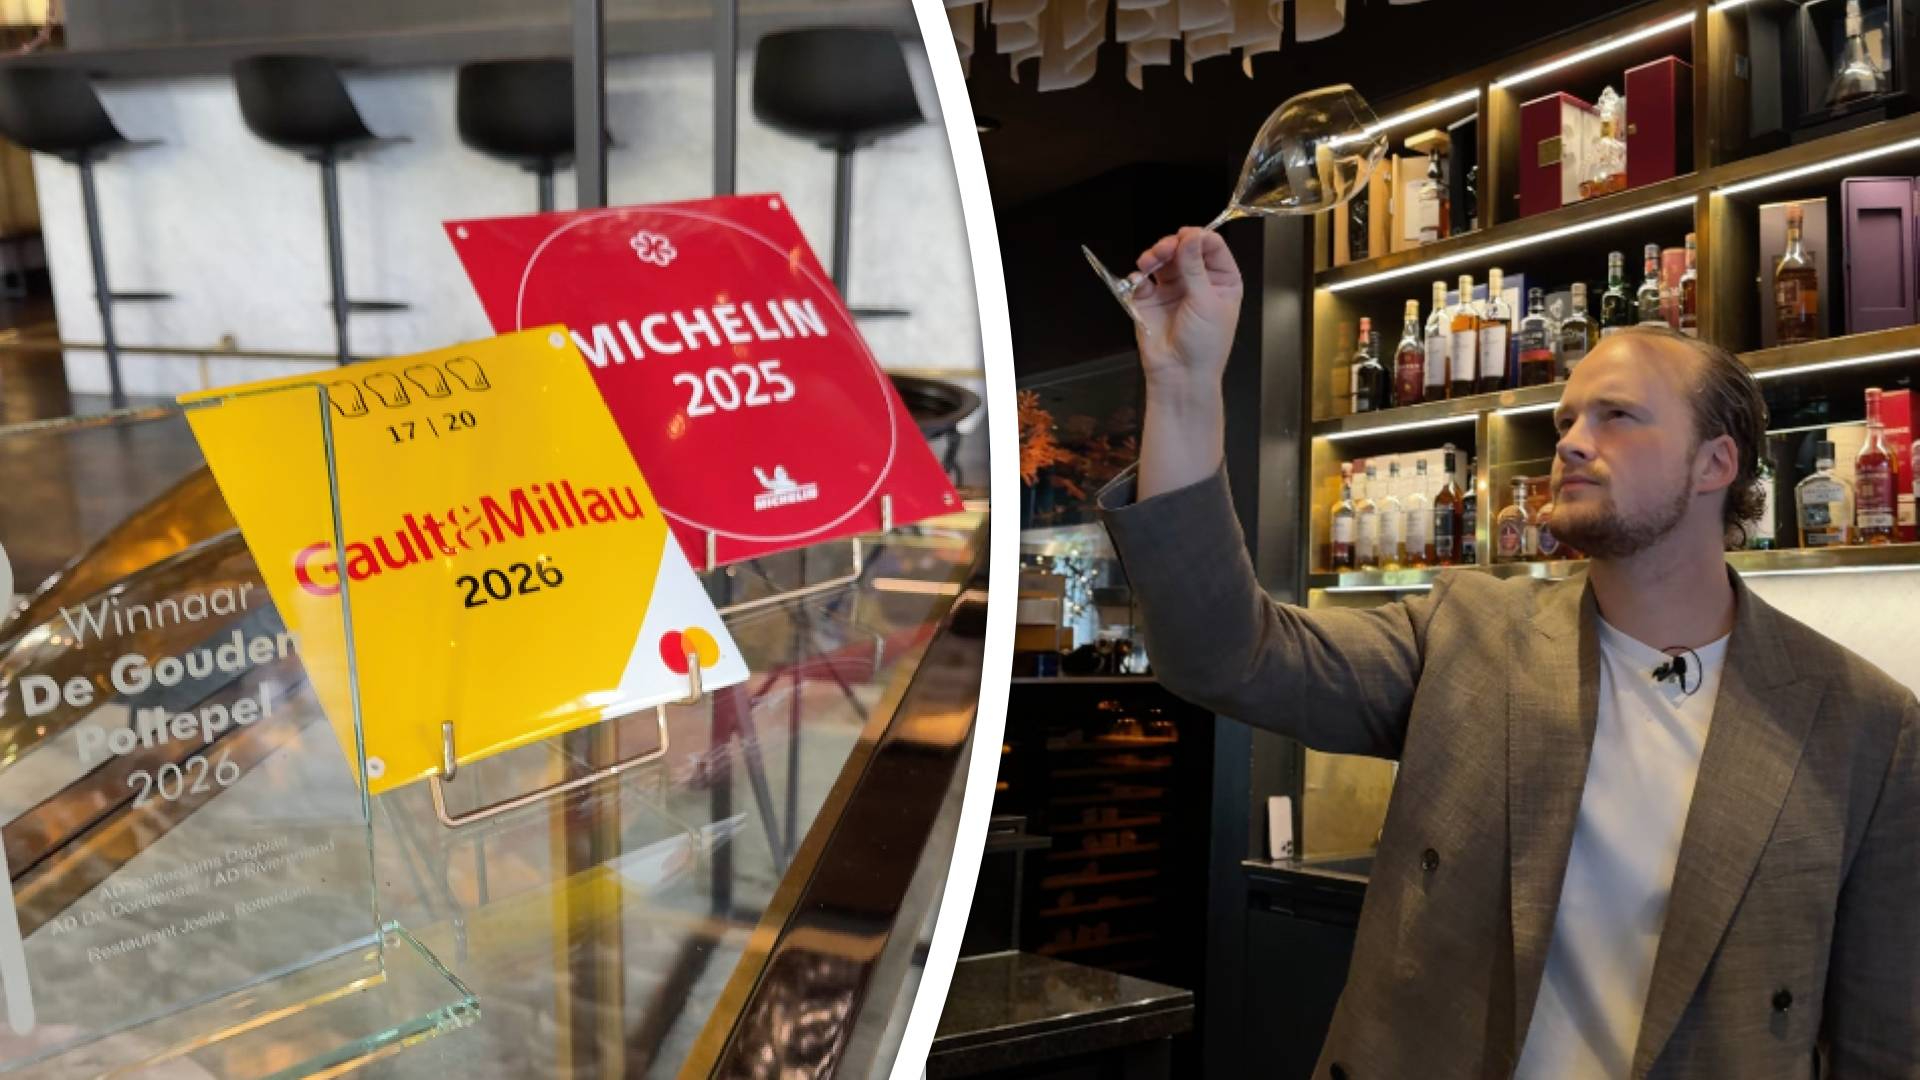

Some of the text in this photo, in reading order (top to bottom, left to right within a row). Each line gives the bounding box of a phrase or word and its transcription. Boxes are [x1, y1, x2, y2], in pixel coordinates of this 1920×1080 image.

[570, 298, 828, 369] MICHELIN
[672, 359, 796, 418] 2025
[386, 421, 415, 443] 17
[442, 410, 476, 431] 20
[294, 479, 645, 597] Gault&Millau
[59, 581, 254, 645] Winnaar
[456, 555, 564, 608] 2026
[20, 628, 300, 717] De Gouden
[127, 747, 240, 809] 2026
